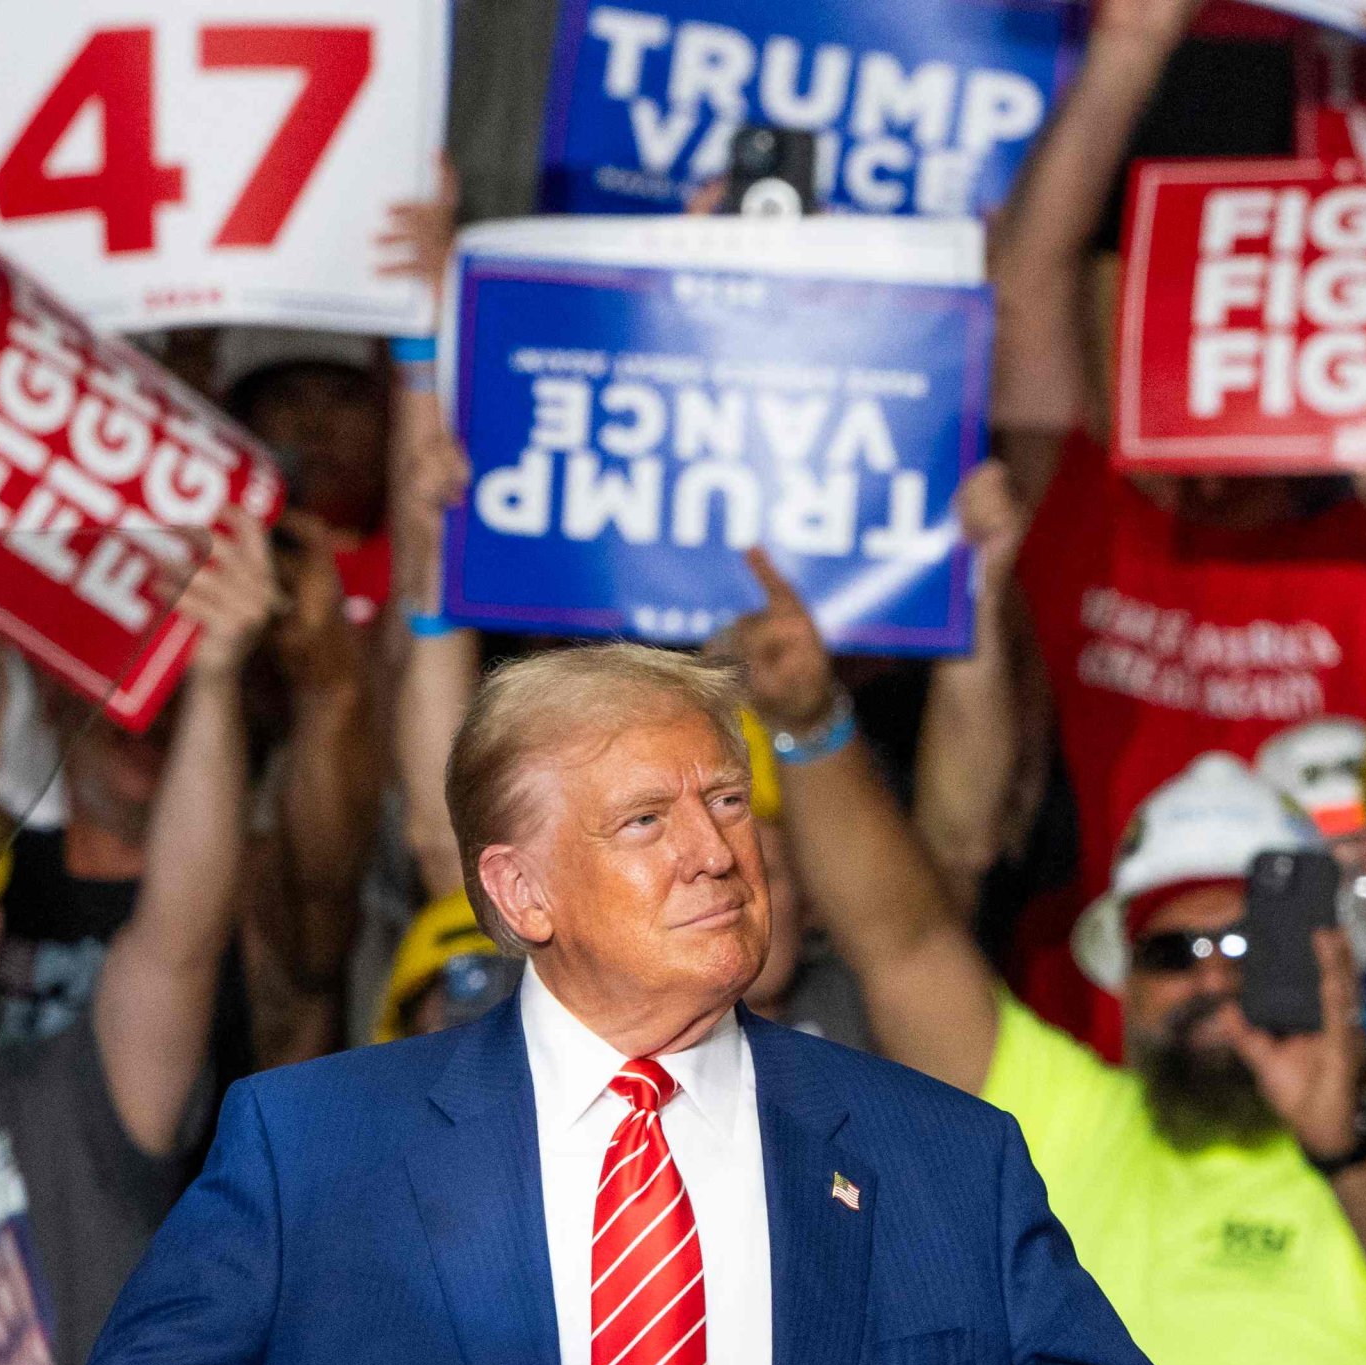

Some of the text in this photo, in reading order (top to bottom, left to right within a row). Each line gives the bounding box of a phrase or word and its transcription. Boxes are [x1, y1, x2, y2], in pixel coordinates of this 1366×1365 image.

[588, 3, 1045, 147] TRUMP
[628, 96, 983, 214] VACE
[528, 375, 899, 472] VANCE
[474, 446, 954, 560] TRUMP
